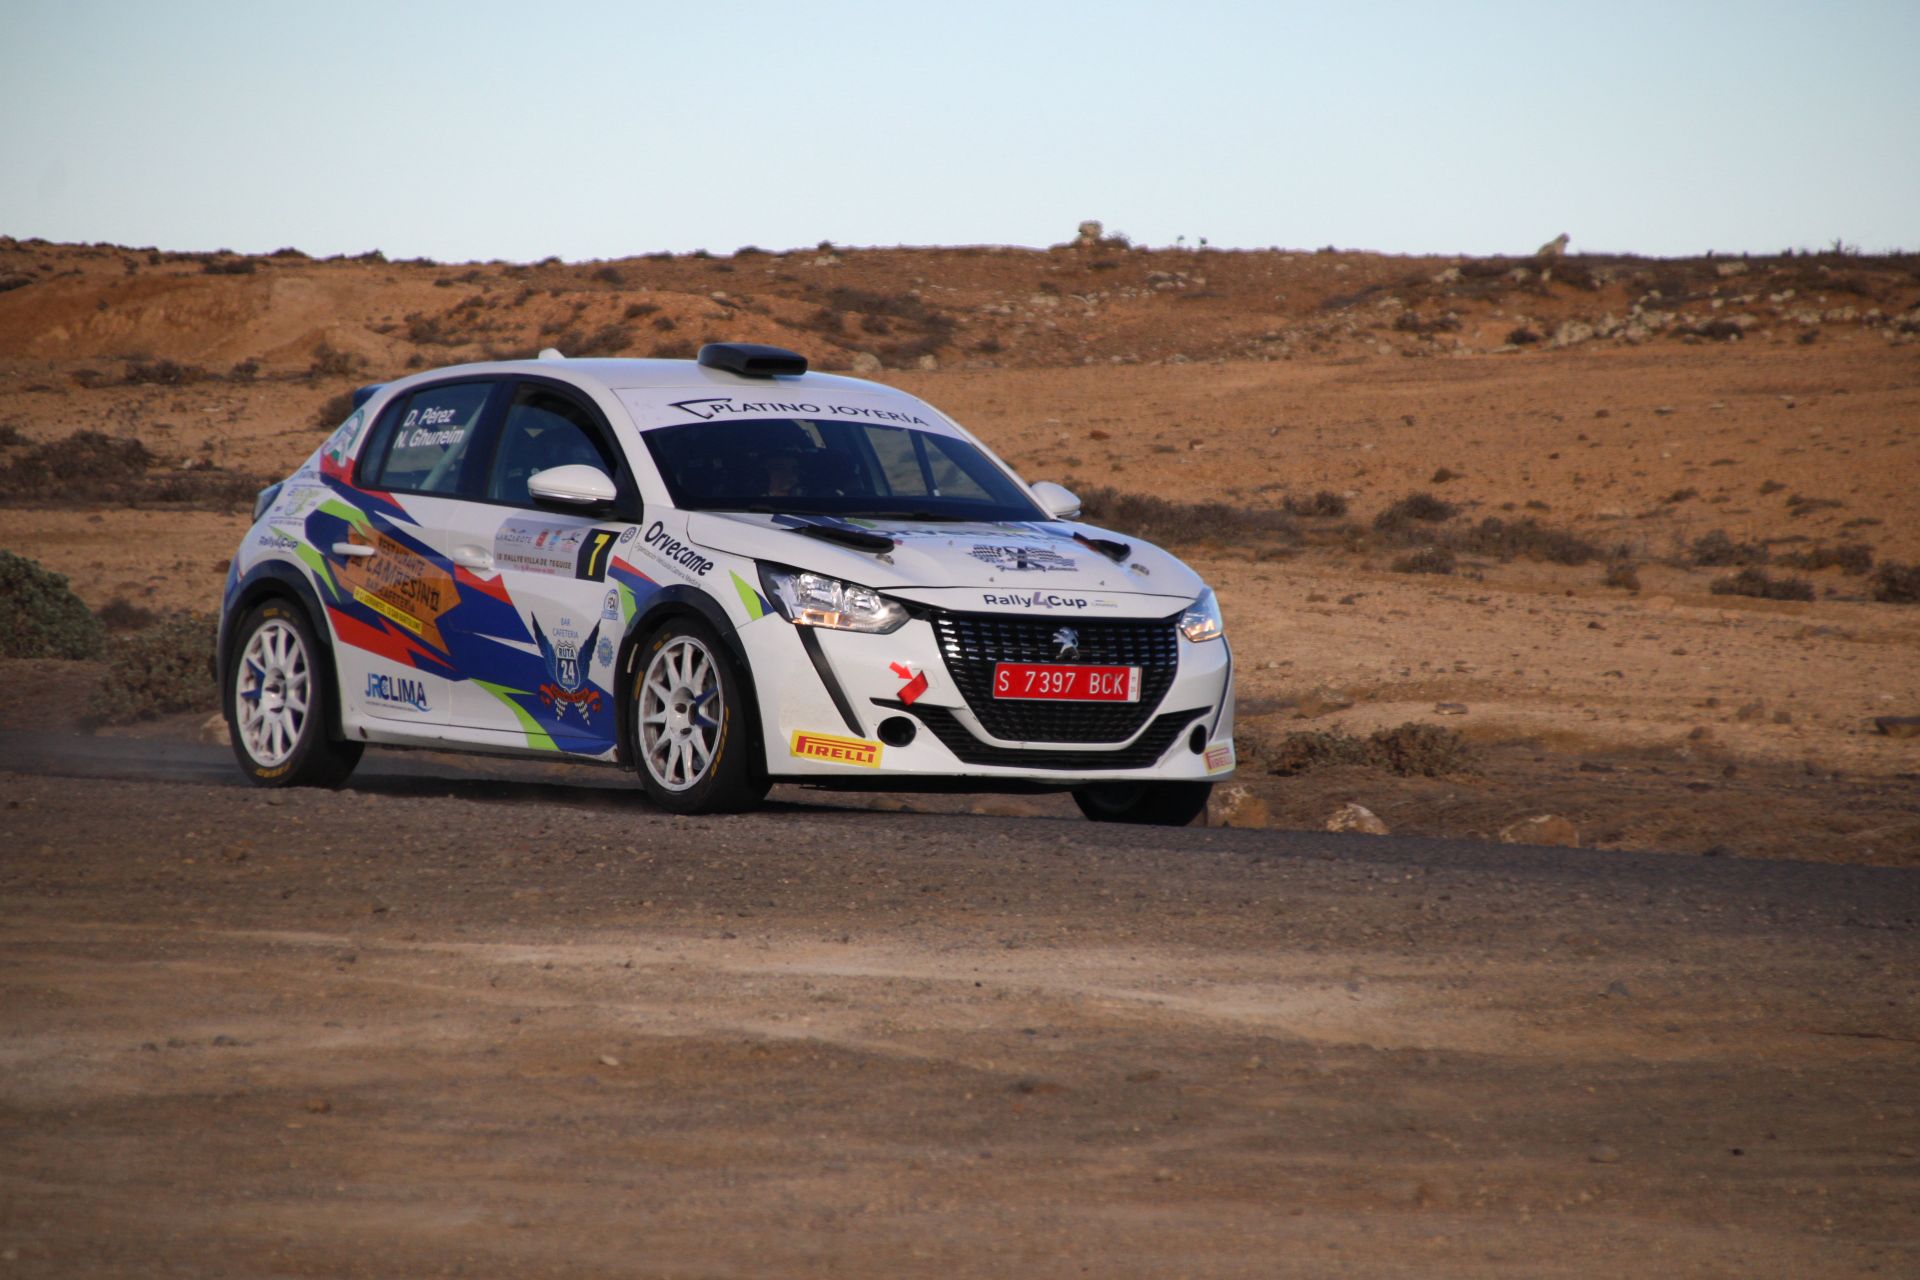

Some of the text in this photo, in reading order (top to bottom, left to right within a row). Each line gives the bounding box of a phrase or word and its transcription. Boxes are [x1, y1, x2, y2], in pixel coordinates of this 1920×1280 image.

[403, 406, 456, 427] D. Pérez
[709, 402, 929, 426] PLATINO JOYERÍA
[393, 426, 465, 449] N. Ghuneim
[588, 533, 610, 576] 7
[644, 520, 714, 576] Orvecame
[983, 591, 1088, 609] Rally4Cup
[561, 617, 571, 626] BAR
[558, 647, 575, 658] RUTA
[560, 660, 575, 679] 24
[998, 670, 1010, 692] S
[1024, 671, 1076, 693] 7397
[1089, 673, 1124, 695] BCK
[796, 735, 877, 763] PIRELLI
